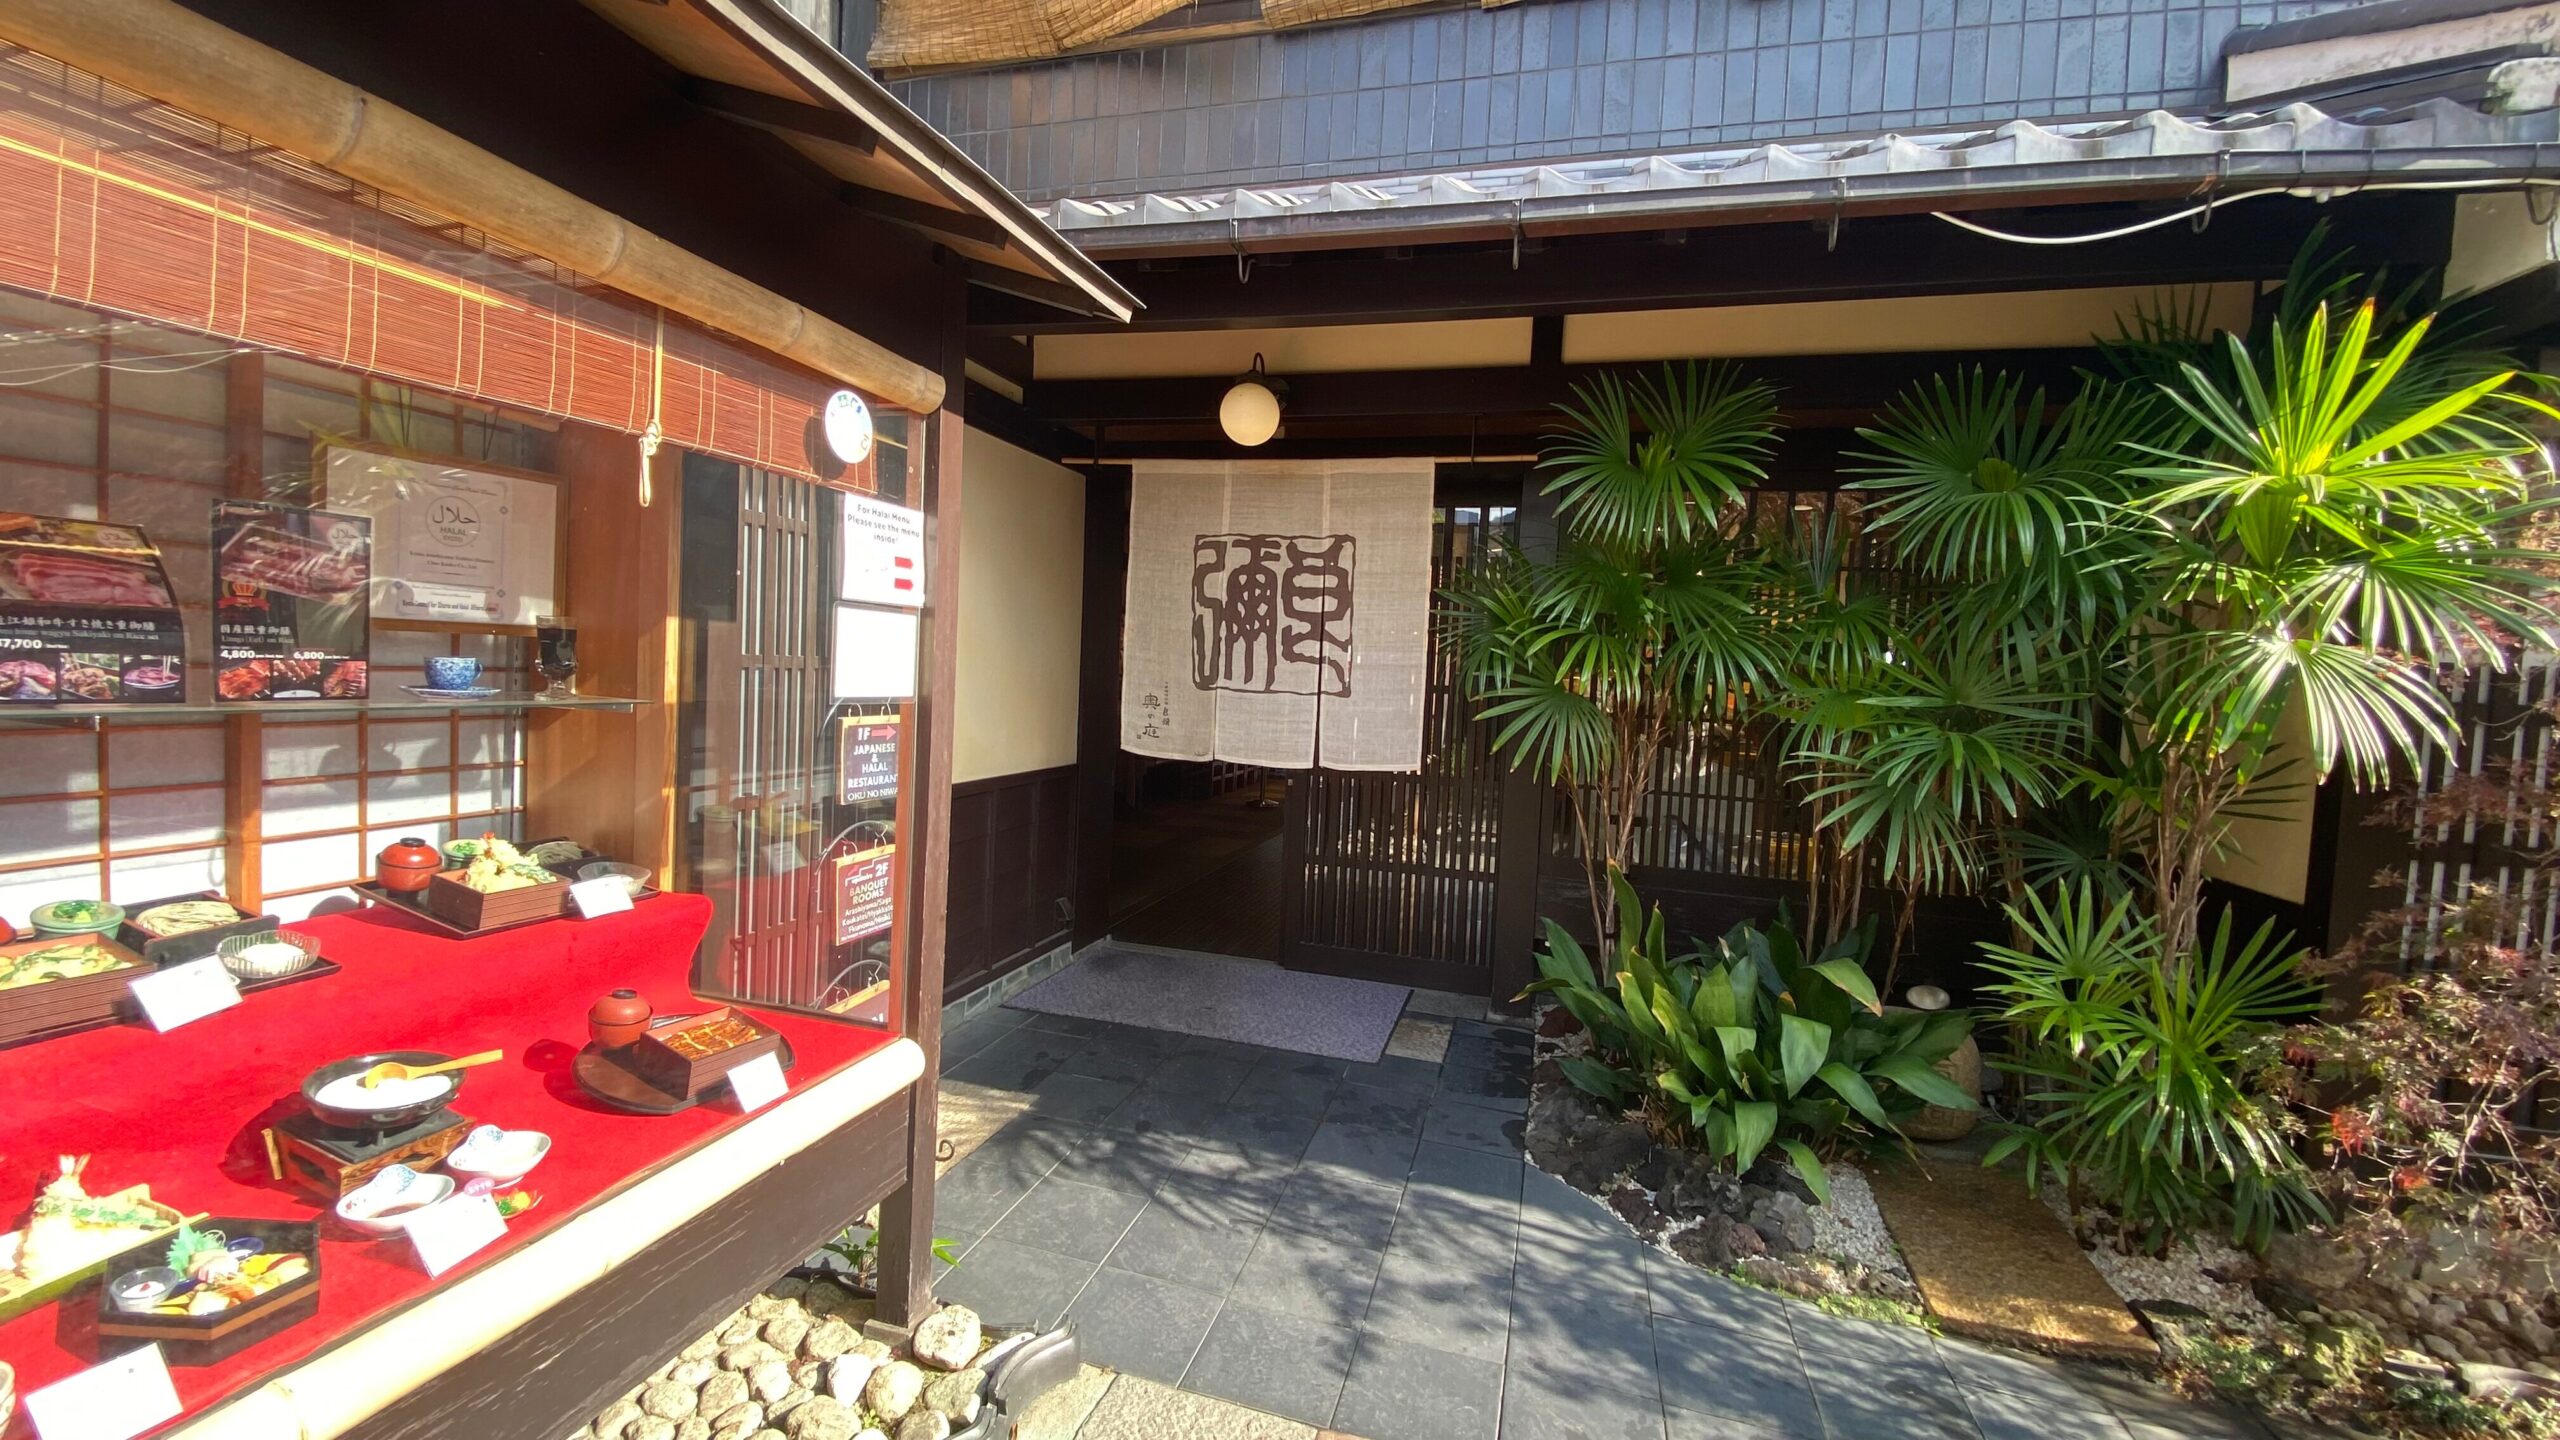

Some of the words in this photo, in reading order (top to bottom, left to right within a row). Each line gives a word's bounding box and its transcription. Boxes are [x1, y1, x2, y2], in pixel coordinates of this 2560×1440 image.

[857, 504, 871, 514] For
[872, 508, 891, 520] Halal
[440, 526, 468, 537] HALAL
[847, 513, 873, 528] Please
[874, 521, 887, 531] see
[888, 525, 899, 533] the
[901, 528, 920, 539] menu
[219, 649, 256, 660] 4,800
[293, 651, 324, 661] 6,800
[857, 727, 871, 741] 1F
[853, 742, 896, 756] JAPANESE
[871, 754, 879, 763] &
[862, 761, 889, 774] HALAL
[847, 790, 866, 801] OKU
[867, 788, 879, 799] NO
[875, 862, 889, 877] 2F
[849, 877, 889, 896] BANQUET
[853, 888, 884, 905] ROOMS
